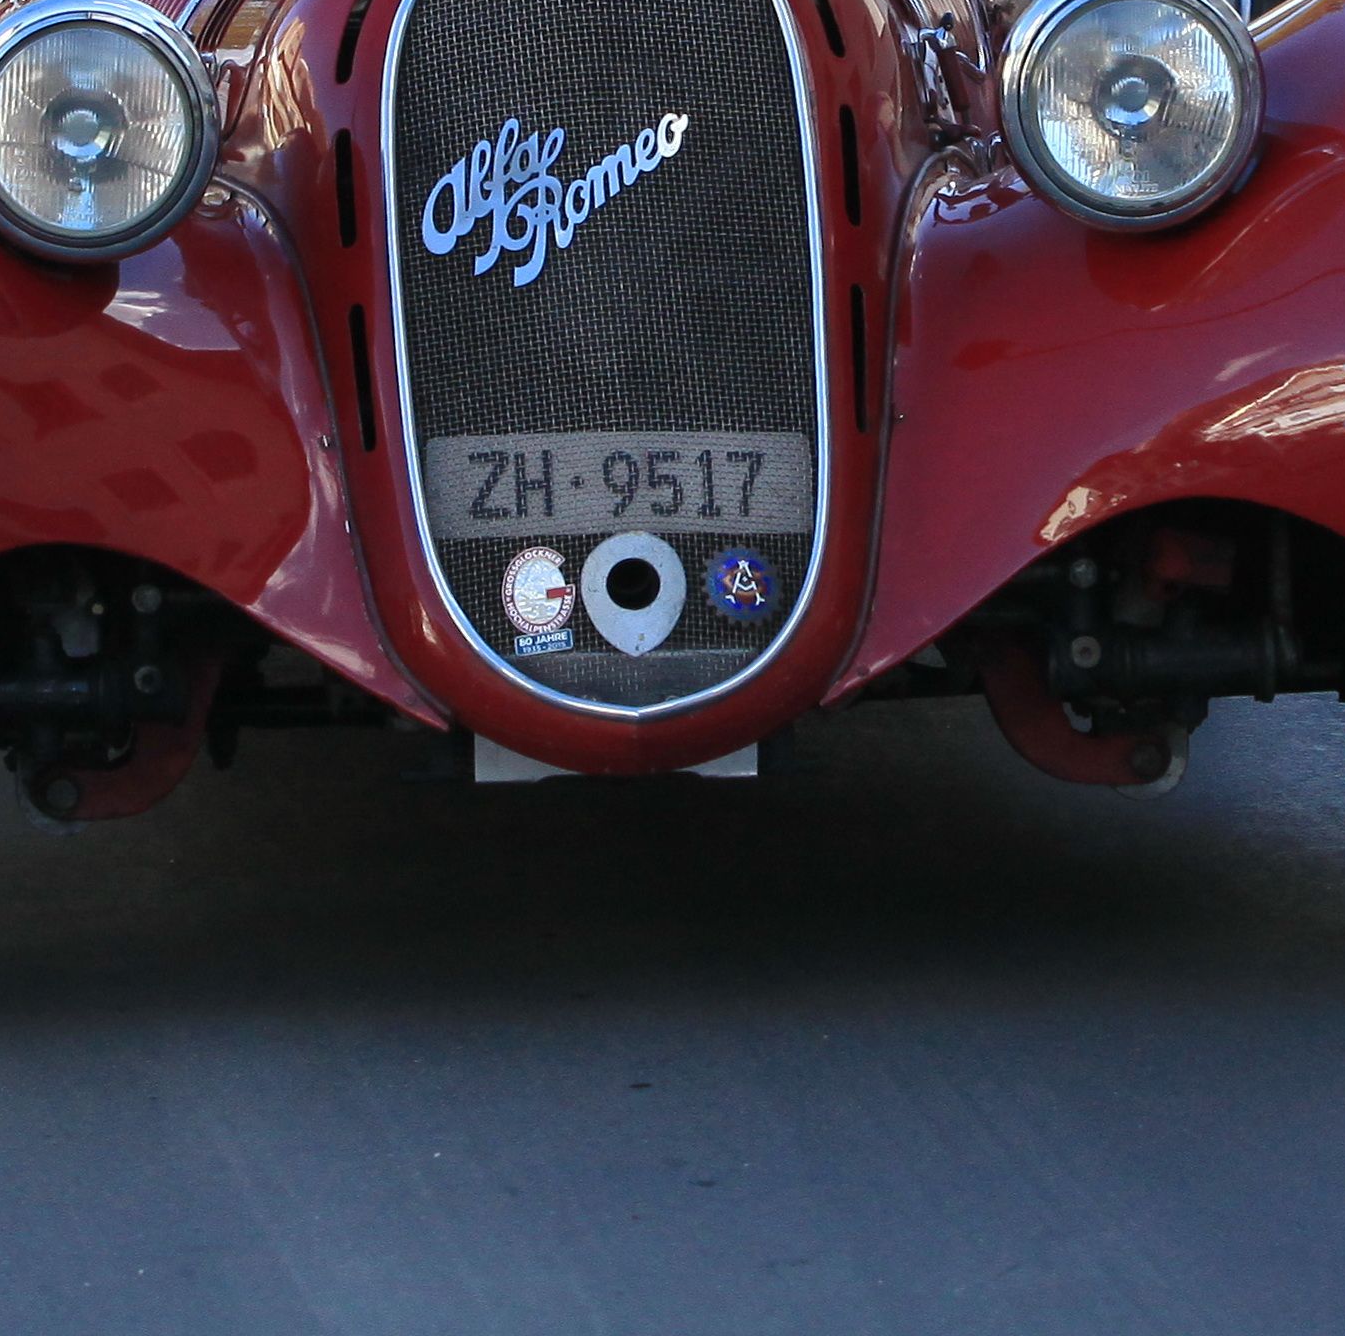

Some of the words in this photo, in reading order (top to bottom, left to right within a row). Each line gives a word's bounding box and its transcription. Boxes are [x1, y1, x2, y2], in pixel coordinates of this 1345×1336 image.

[422, 117, 543, 277] Alfa
[503, 112, 689, 288] Romeo
[468, 450, 554, 517] ZH
[603, 449, 765, 517] 9517
[518, 637, 534, 648] 80
[535, 631, 569, 645] JAHRE
